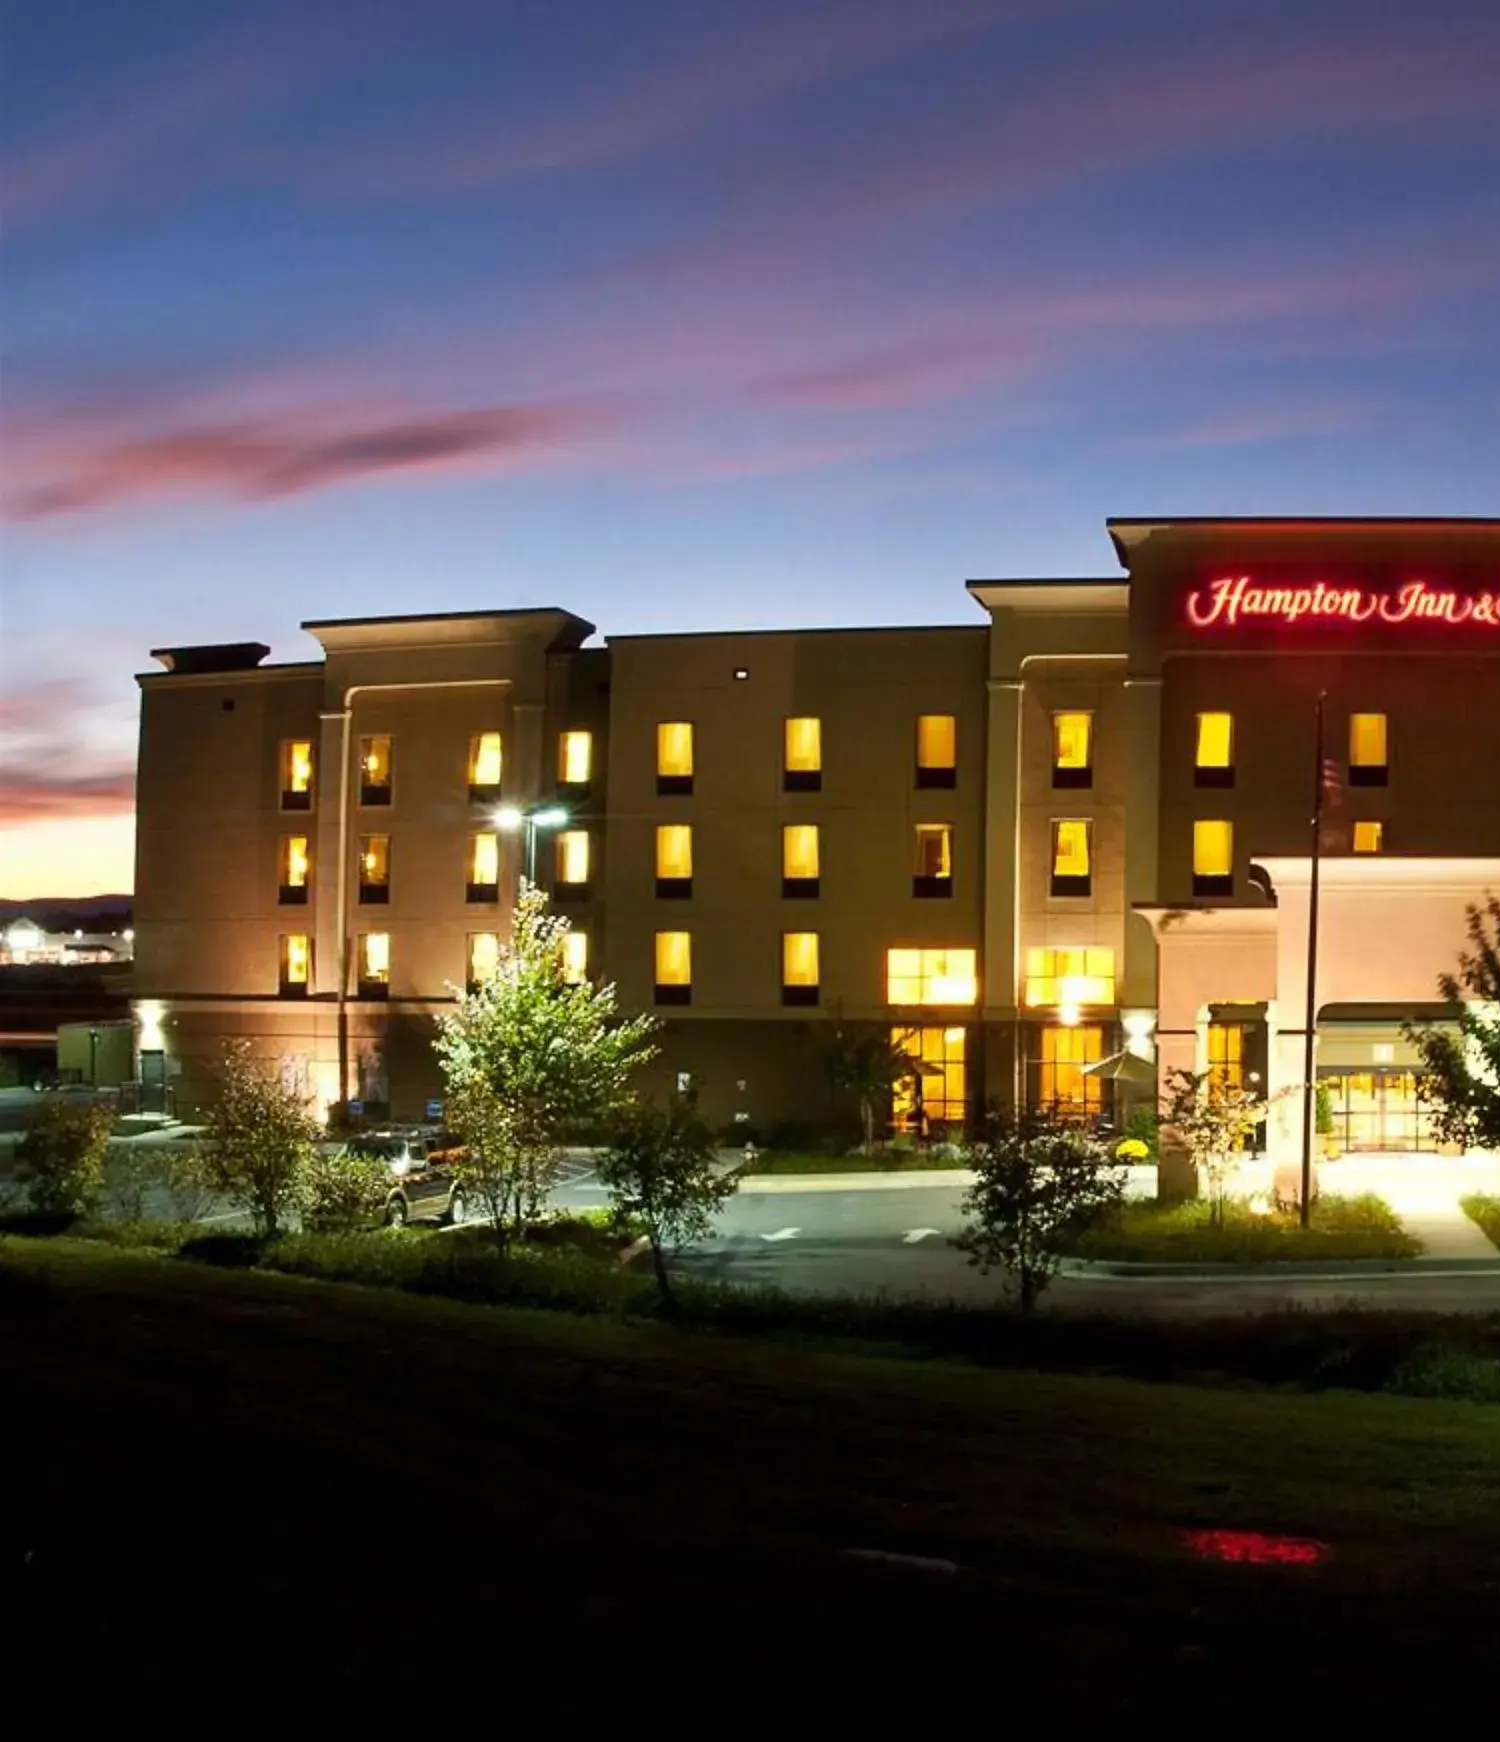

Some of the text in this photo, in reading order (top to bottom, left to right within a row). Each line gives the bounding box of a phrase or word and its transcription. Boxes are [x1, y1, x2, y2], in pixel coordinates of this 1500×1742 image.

[1188, 576, 1378, 625] Hampton
[1379, 581, 1474, 623] Inn
[1472, 593, 1500, 625] &
